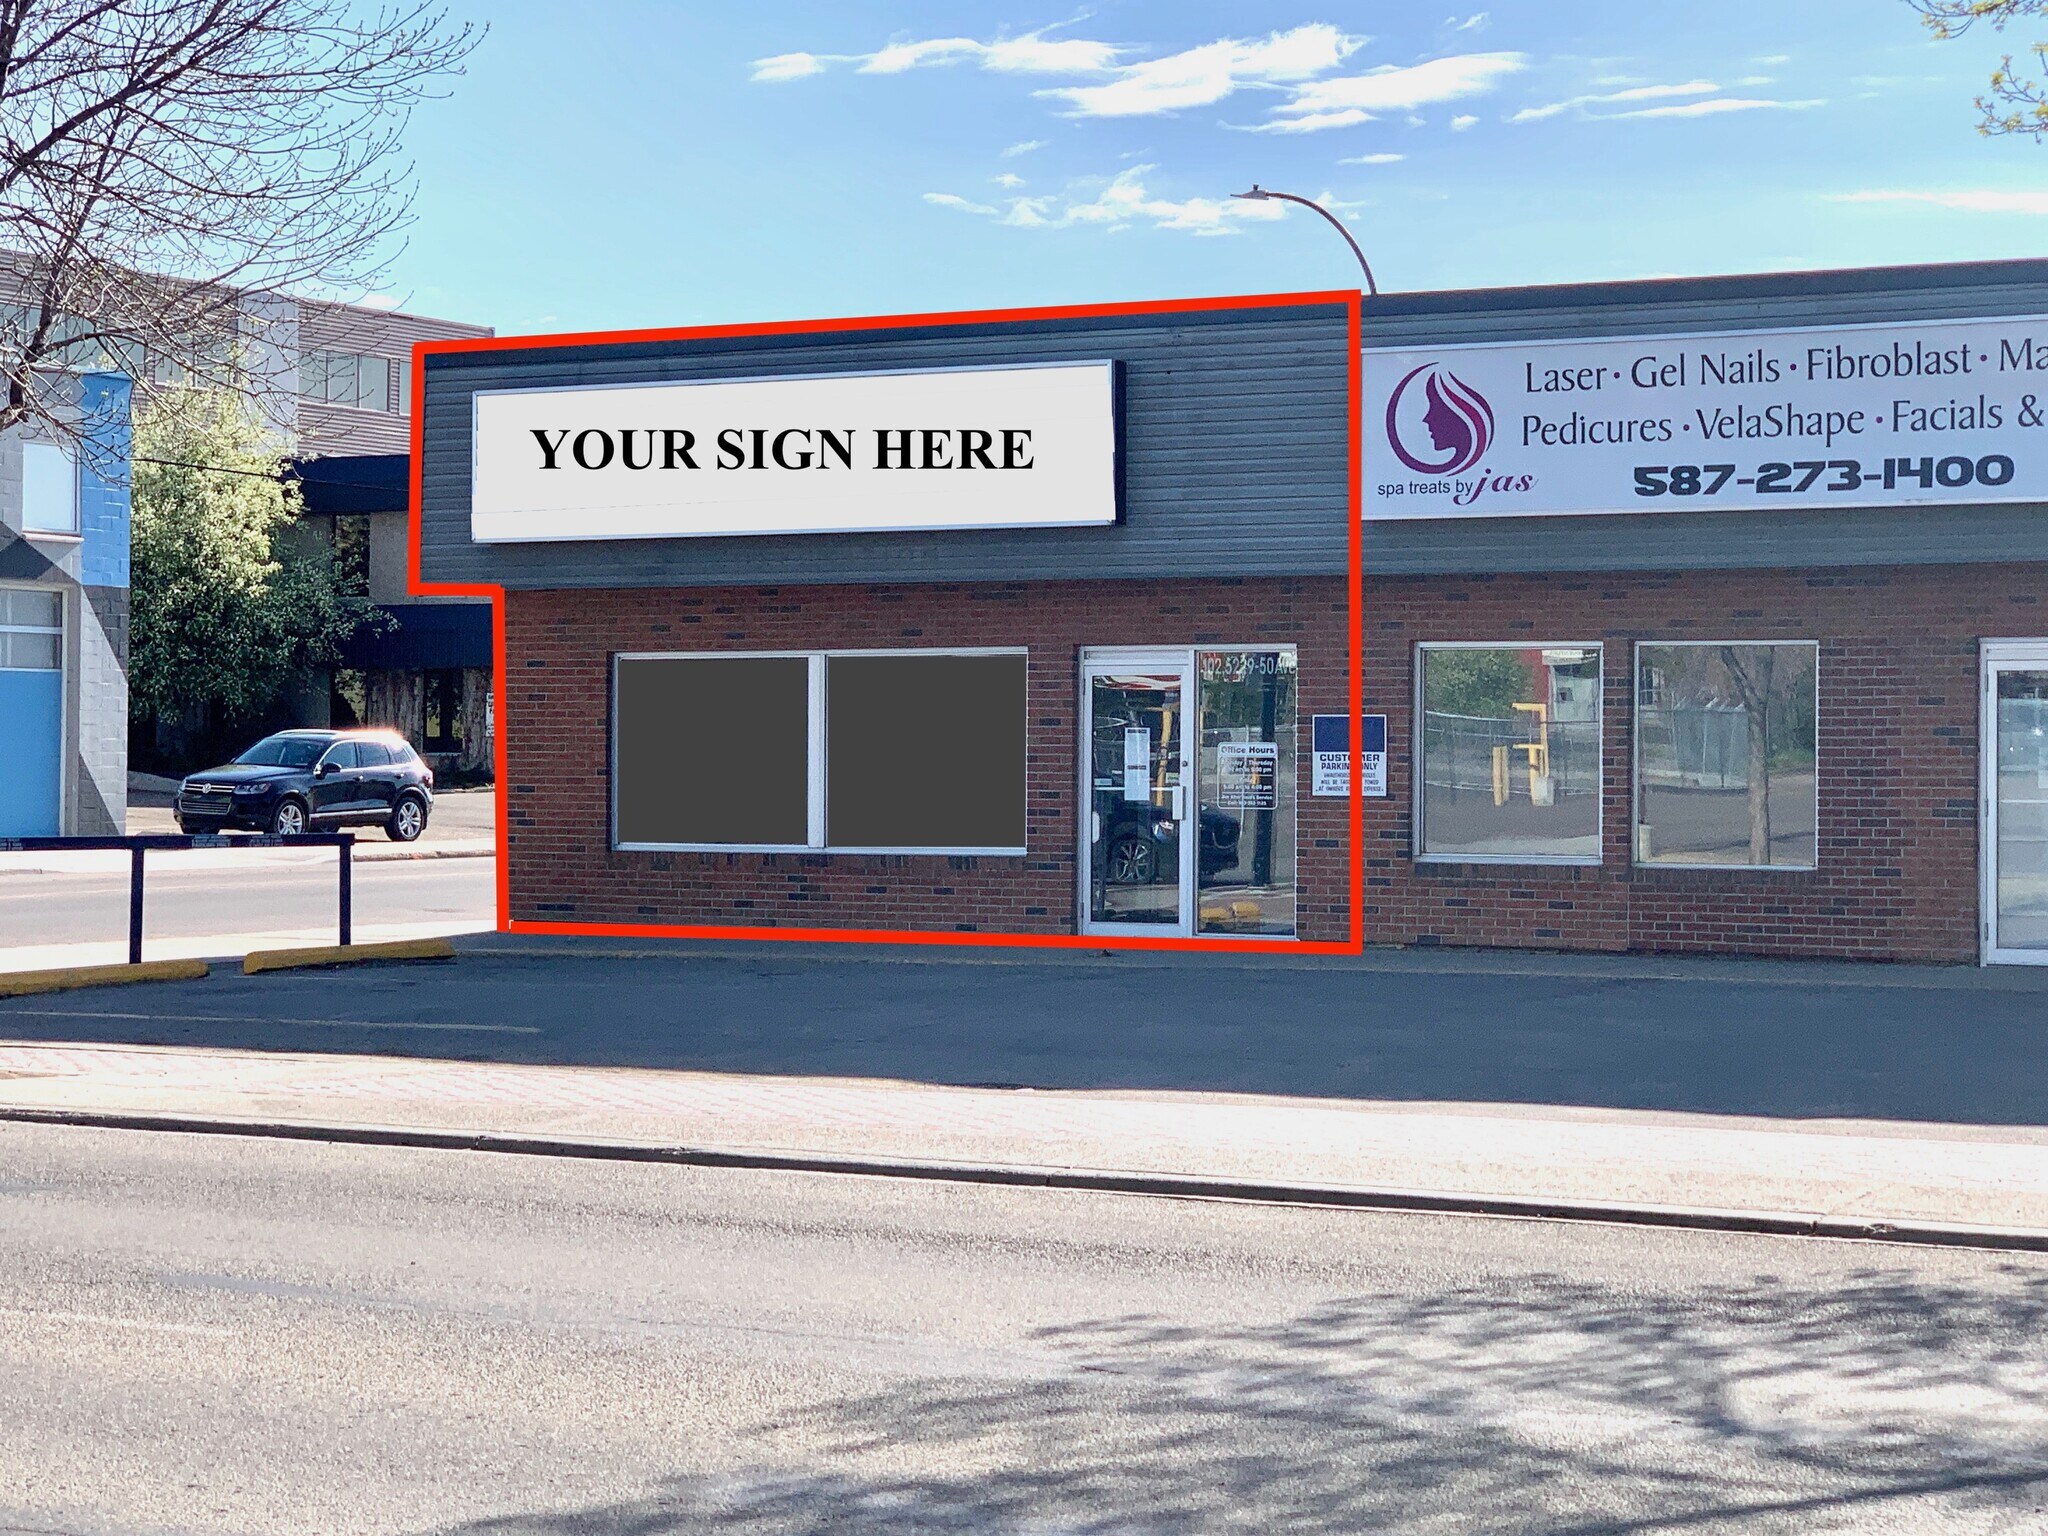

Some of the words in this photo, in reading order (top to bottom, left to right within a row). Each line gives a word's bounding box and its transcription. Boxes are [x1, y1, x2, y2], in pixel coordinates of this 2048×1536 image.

[1525, 362, 1607, 393] Laser
[1630, 354, 1686, 390] Gel
[1700, 349, 1780, 386] Nails
[1806, 342, 1972, 380] Fibroblast
[1522, 408, 1674, 447] Pedicures
[1696, 404, 1866, 449] VelaShape
[1892, 394, 2003, 432] Facials
[2018, 394, 2045, 428] &
[1409, 480, 1450, 495] treats
[1452, 468, 1540, 506] jas
[1455, 479, 1473, 497] by
[1634, 454, 2016, 498] 587-273-1400
[1377, 483, 1404, 499] spa
[1320, 754, 1380, 762] CUSTER
